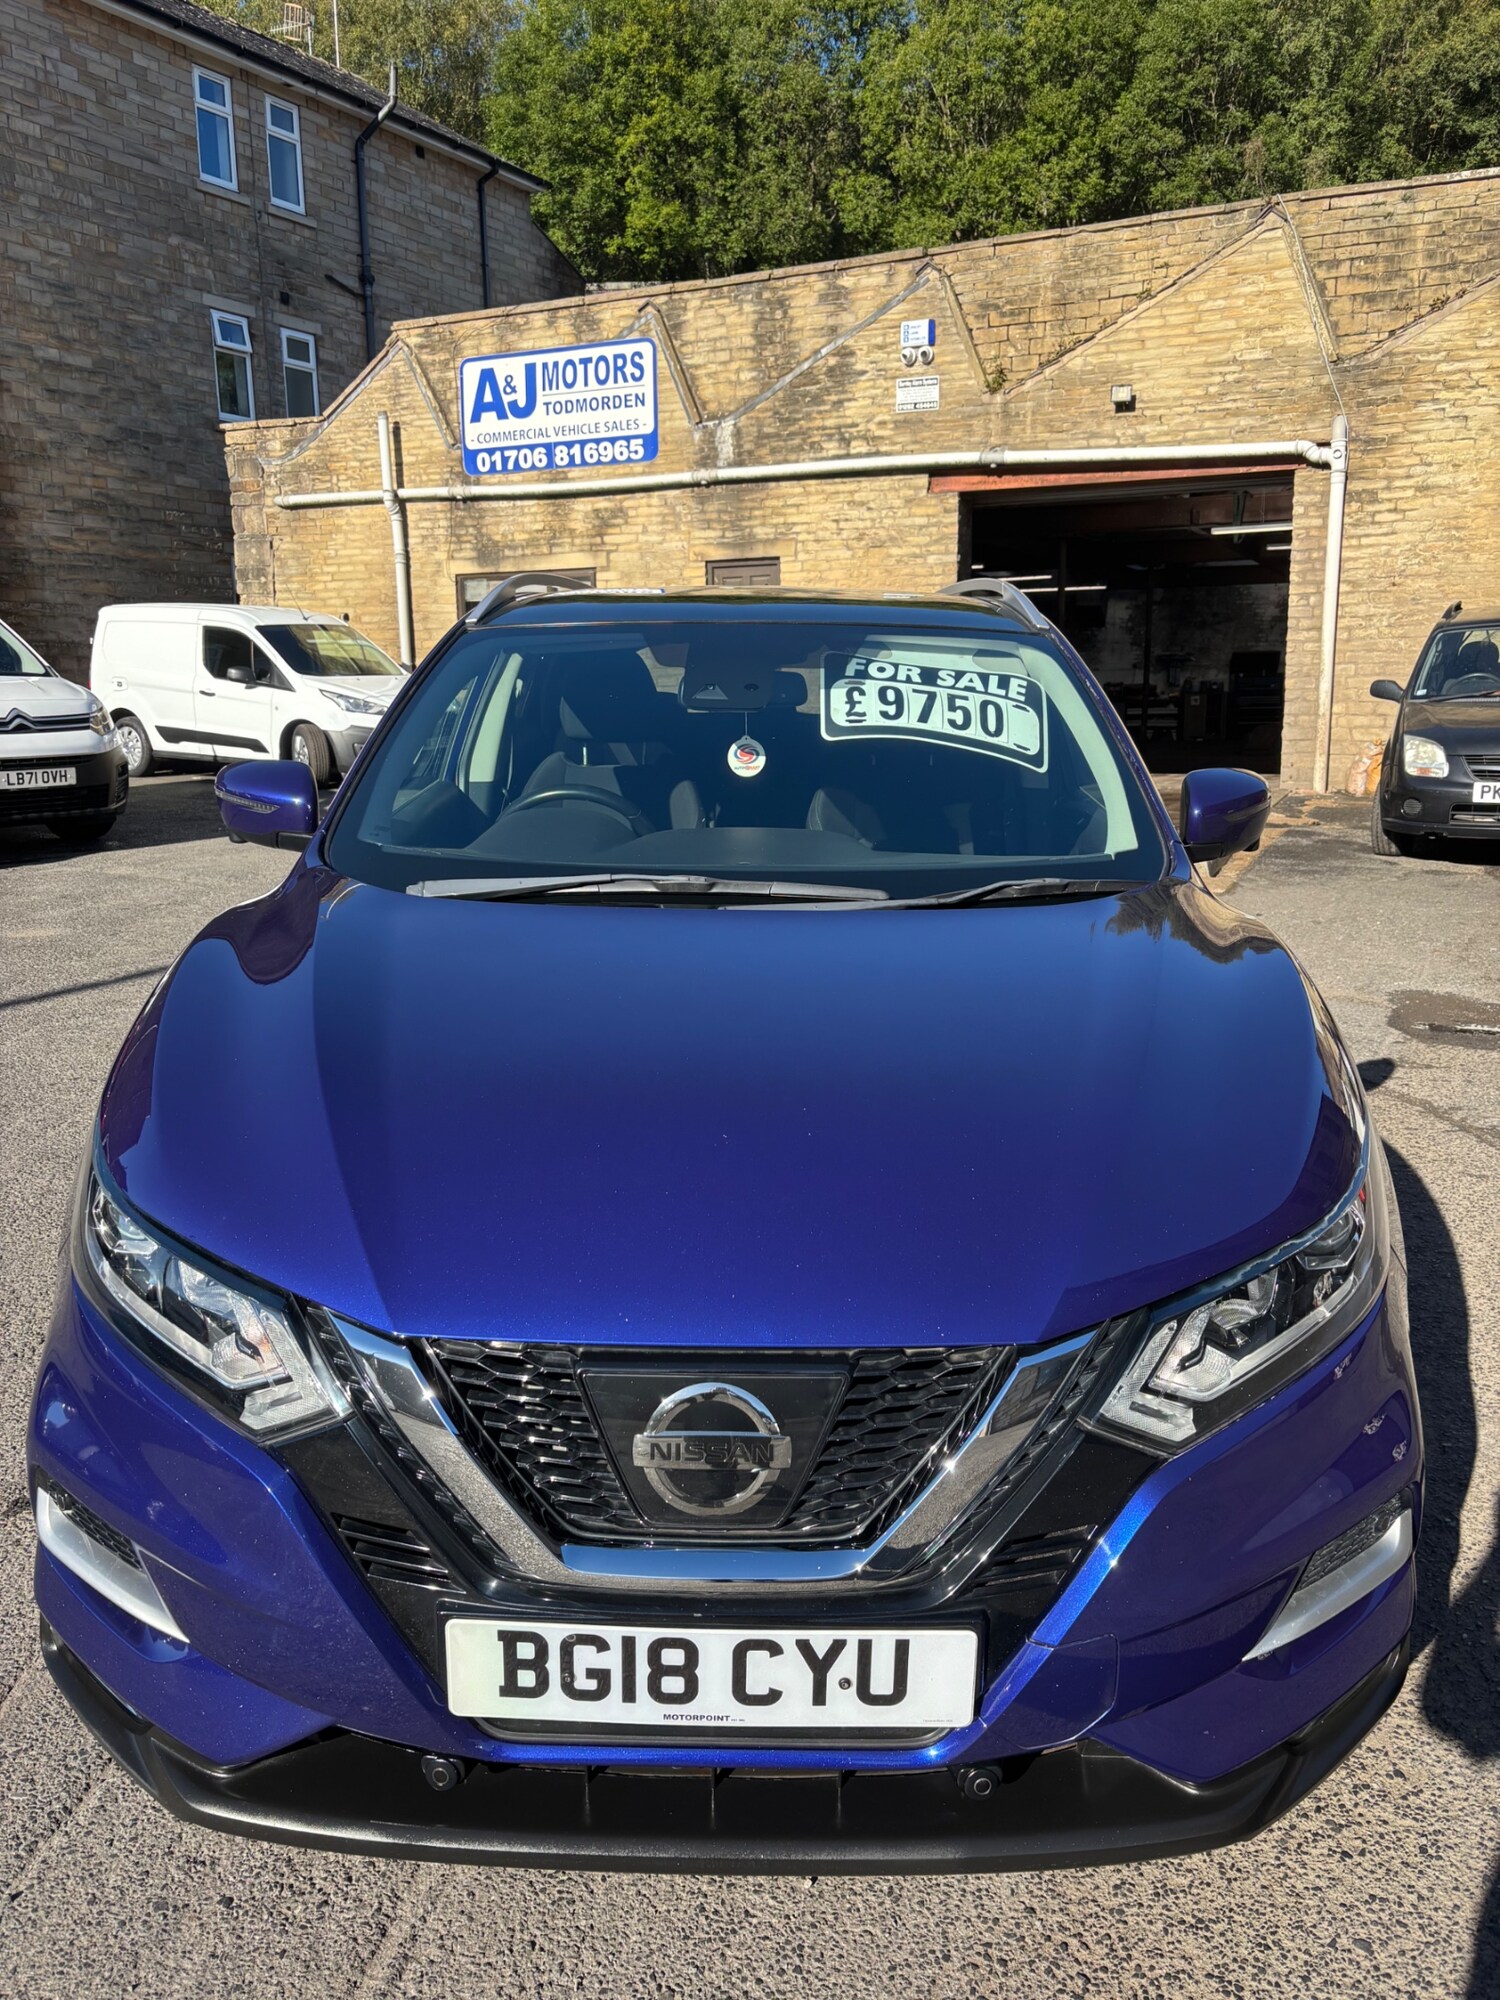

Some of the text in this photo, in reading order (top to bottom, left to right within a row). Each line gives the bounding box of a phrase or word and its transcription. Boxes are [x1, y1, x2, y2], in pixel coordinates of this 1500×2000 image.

[470, 351, 645, 424] A&J MOTORS
[543, 392, 646, 416] TODMORDEN
[477, 418, 640, 444] COMMERCIAL VEHICLE SALES
[476, 438, 645, 473] 01706 816965
[844, 658, 1028, 702] FOR SALE
[845, 685, 1004, 738] £9750
[6, 769, 68, 786] LB71 OVH
[649, 1442, 774, 1463] NISSAN
[496, 1629, 910, 1707] BG18 CYU
[663, 1713, 731, 1722] MOTORPOINT
